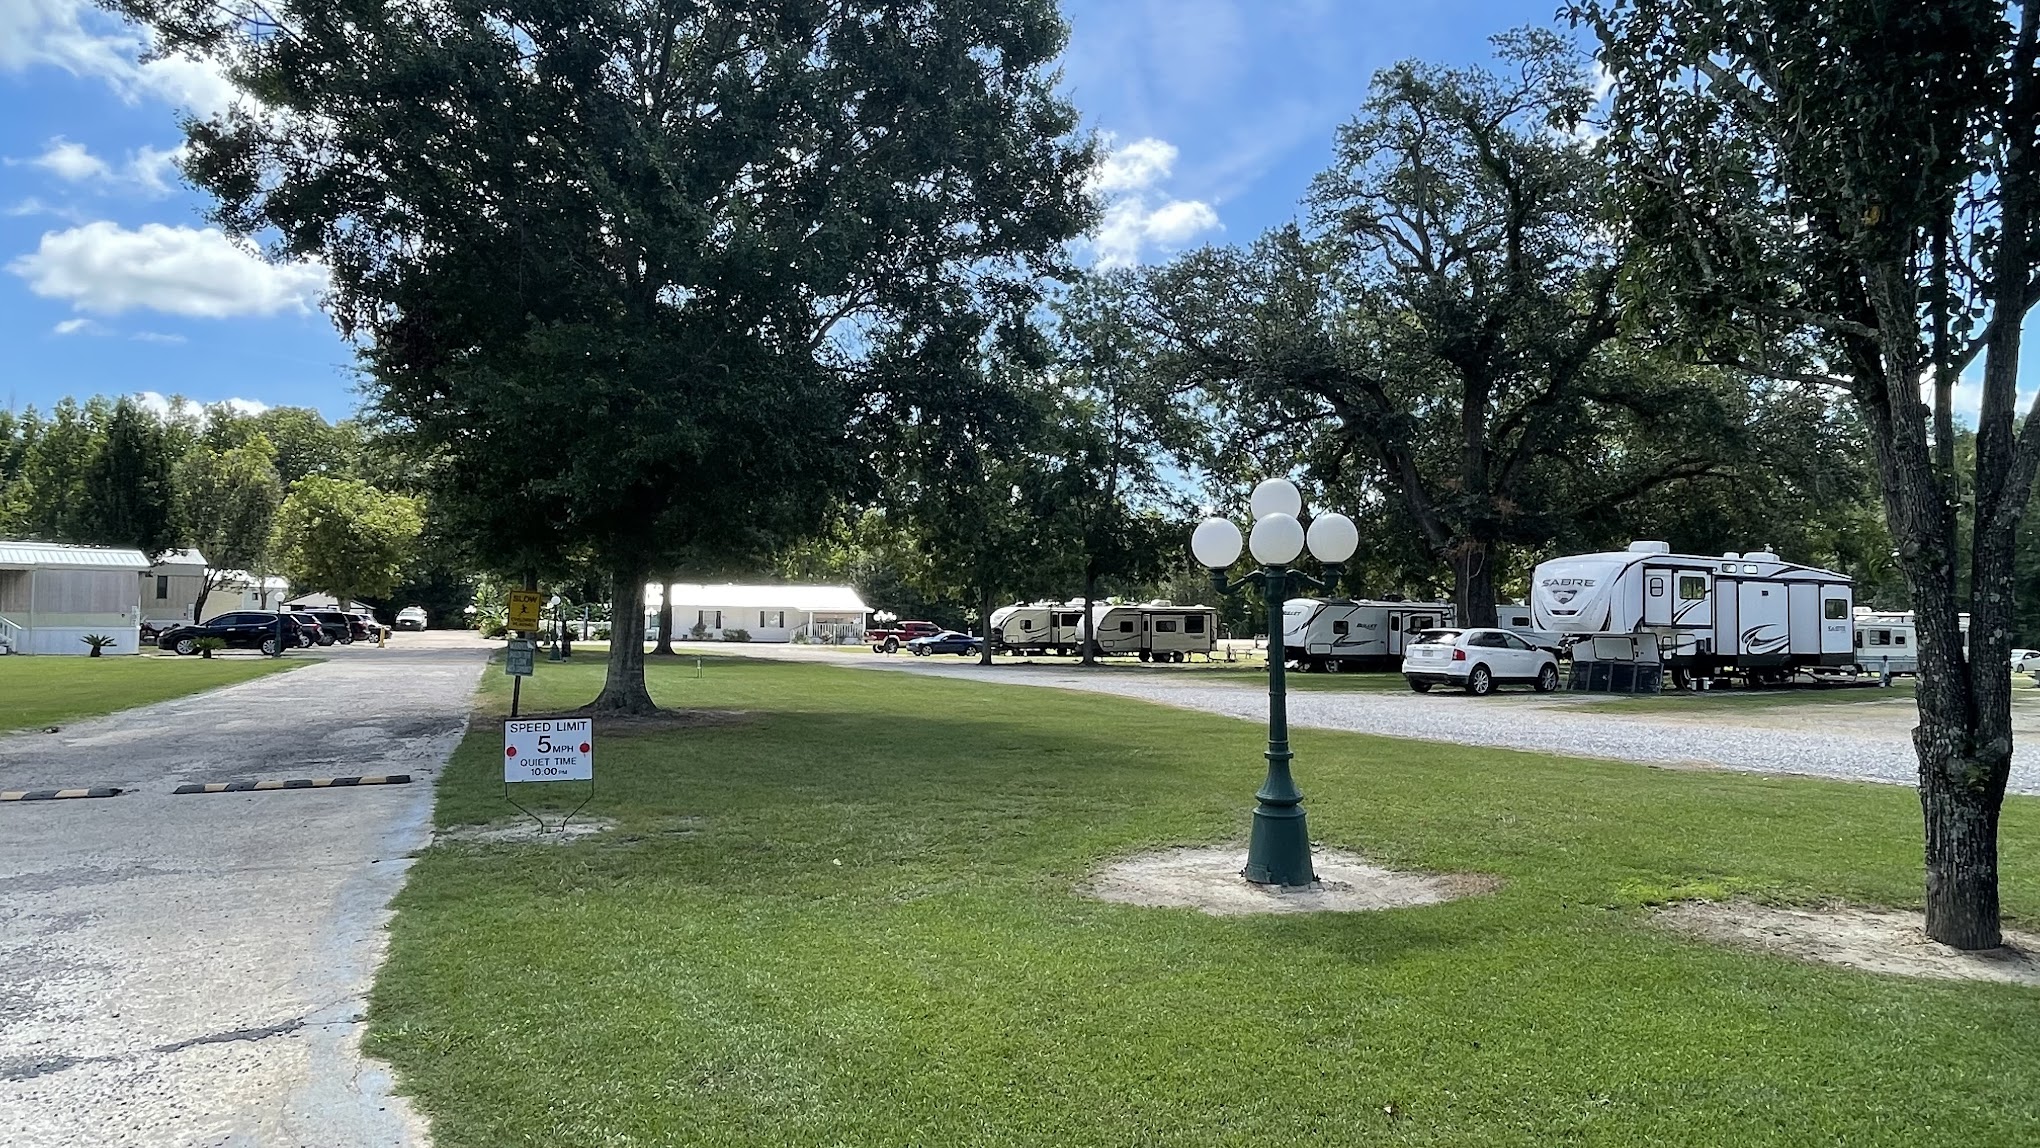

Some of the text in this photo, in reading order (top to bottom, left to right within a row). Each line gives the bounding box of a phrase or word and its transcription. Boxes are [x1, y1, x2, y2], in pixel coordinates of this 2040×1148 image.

[1541, 579, 1596, 587] SABRE
[513, 595, 537, 603] SLOW
[510, 721, 587, 733] SPEED LIMIT
[537, 735, 574, 753] 5 MPH
[520, 757, 577, 767] QUIET TIME
